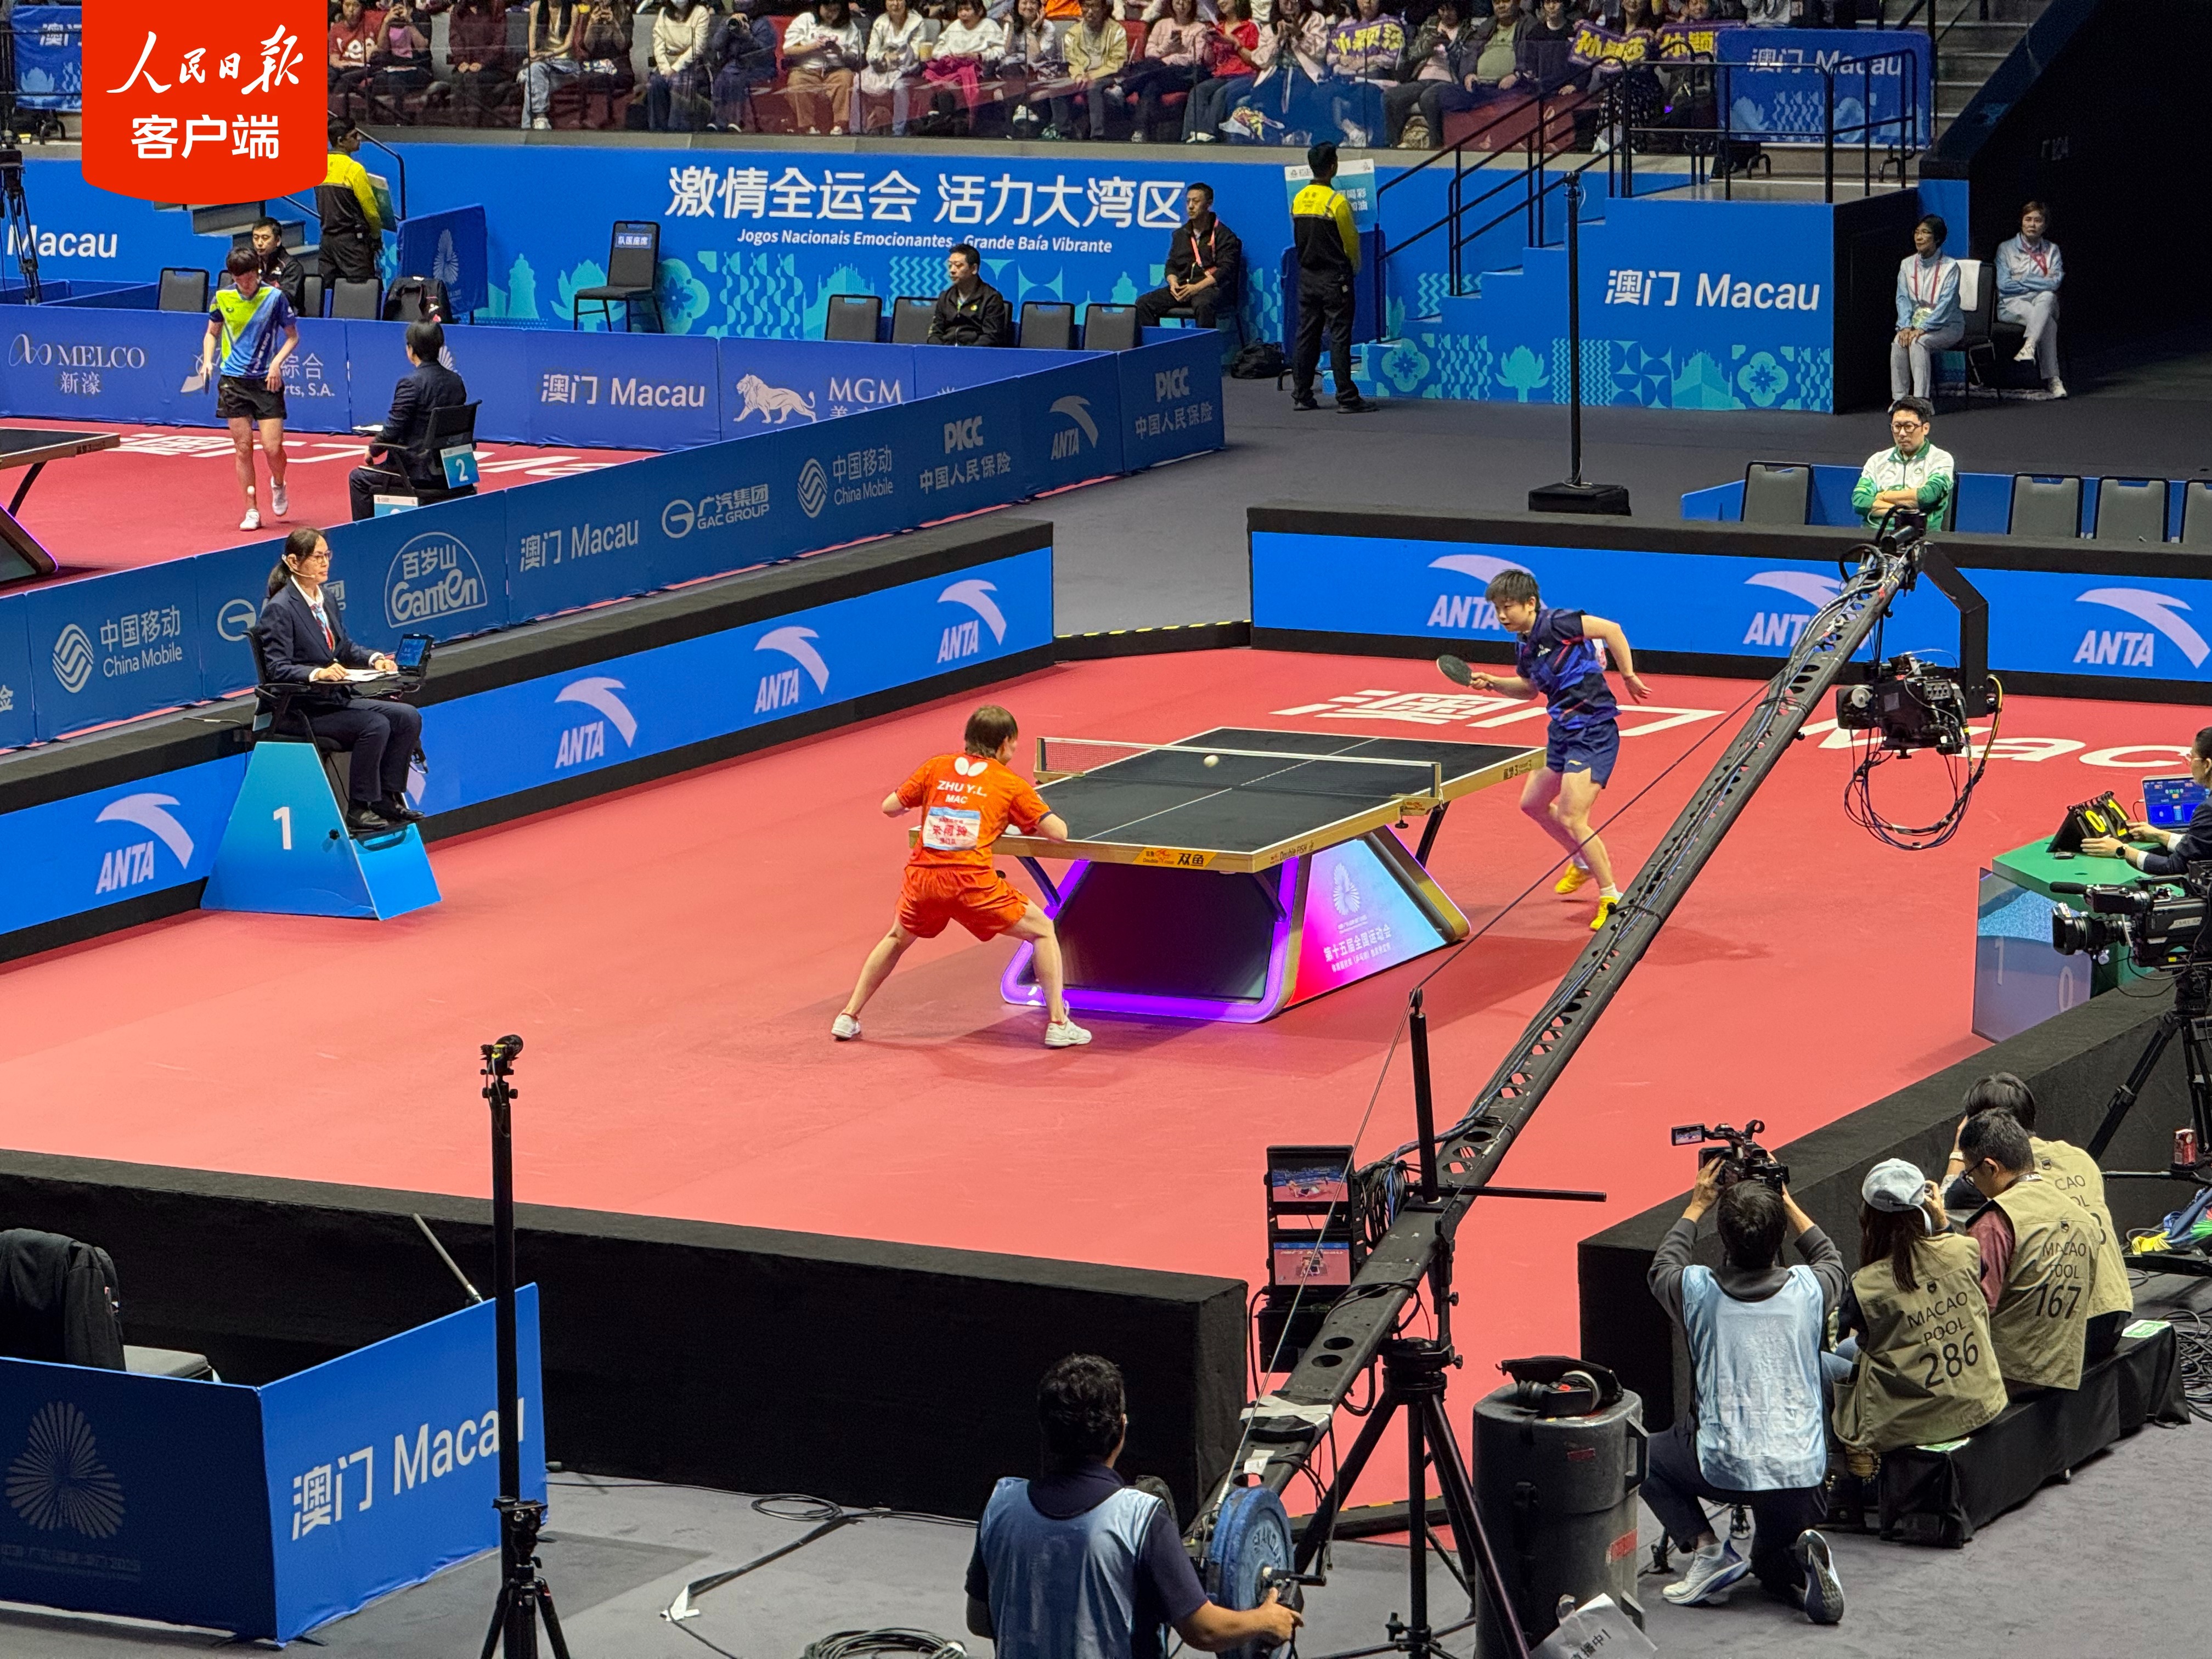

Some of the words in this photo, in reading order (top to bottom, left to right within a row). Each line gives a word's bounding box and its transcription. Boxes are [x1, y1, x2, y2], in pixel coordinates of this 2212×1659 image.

[1750, 48, 1802, 74] 澳门
[1815, 49, 1902, 76] Macau
[665, 166, 921, 223] 激情全运会
[933, 173, 1186, 229] 活力大湾区
[738, 228, 778, 247] Jogos
[781, 229, 850, 245] Nacionais
[963, 234, 1015, 251] Grande
[1018, 236, 1049, 252] Baía
[1053, 237, 1113, 253] Vibrante
[1606, 269, 1680, 307] 澳门
[1696, 273, 1820, 311] Macau
[57, 345, 145, 369] MELCO
[60, 371, 101, 395] 新濠
[541, 374, 598, 405] 澳门
[611, 377, 705, 408] Macau
[828, 377, 904, 404] MGM
[1154, 366, 1190, 402] PICC
[944, 415, 985, 454] PICC
[1135, 402, 1214, 440] 中国人民保险
[1051, 428, 1080, 461] ANTA
[456, 459, 469, 482] 2
[832, 444, 893, 483] 中国移动
[919, 452, 1012, 494] 中国人民保险
[697, 483, 769, 517] 广汽集团
[834, 485, 861, 506] China
[863, 478, 894, 500] Mobile
[697, 512, 723, 530] GAC
[725, 504, 770, 524] GROUP
[401, 544, 458, 580] 百岁山
[520, 531, 562, 573] 澳门
[571, 519, 639, 560] Macau
[100, 604, 182, 653] 中国移动
[1427, 595, 1500, 631] ANTA
[1742, 611, 1810, 648] ANT
[937, 620, 980, 664] ANTA
[2074, 630, 2155, 668] ANTA
[103, 653, 139, 679] China
[141, 642, 183, 672] Mobile
[754, 668, 799, 715] ANTA
[1269, 689, 1727, 737] 澳门
[555, 721, 604, 769] ANTA
[937, 780, 964, 792] ZHU
[966, 784, 987, 797] Y.L.
[945, 794, 968, 804] MAC
[273, 806, 291, 850] 1
[2085, 810, 2106, 833] 0
[95, 840, 155, 895] ANTA
[1177, 853, 1204, 867] 双鱼
[1323, 924, 1392, 962] 第十五届全国运动会
[2055, 1175, 2086, 1190] CAO
[1907, 1292, 1968, 1328] MACAO
[2033, 1283, 2081, 1319] 167
[1923, 1317, 1967, 1346] POOL
[1918, 1331, 1978, 1389] 286
[292, 1446, 374, 1541] 澳门
